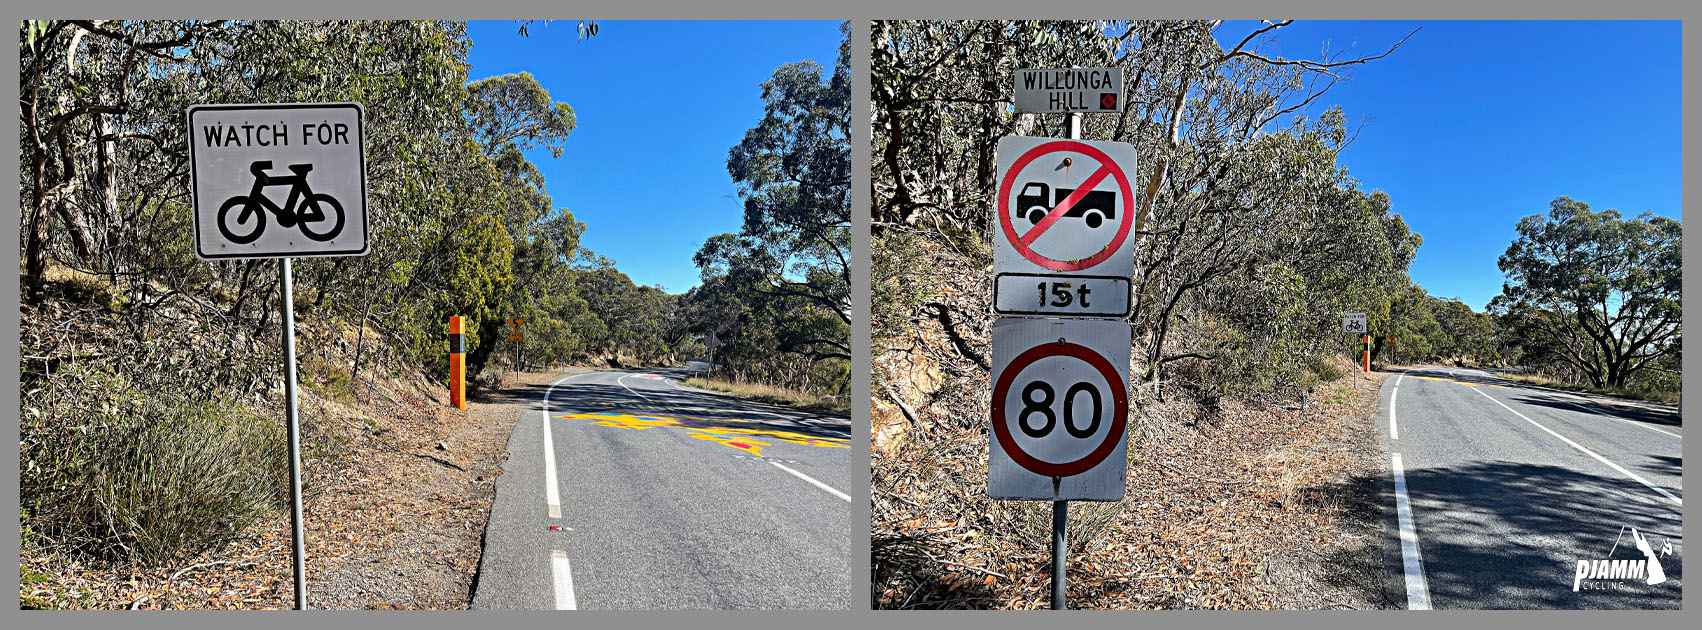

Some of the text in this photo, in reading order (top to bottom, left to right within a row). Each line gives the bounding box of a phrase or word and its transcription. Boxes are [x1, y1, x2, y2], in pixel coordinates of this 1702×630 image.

[1023, 71, 1112, 90] WILLUNGA
[1049, 92, 1088, 110] HILL
[203, 123, 349, 147] WATCH FOR
[1037, 282, 1091, 308] 15t
[1018, 381, 1102, 439] 80
